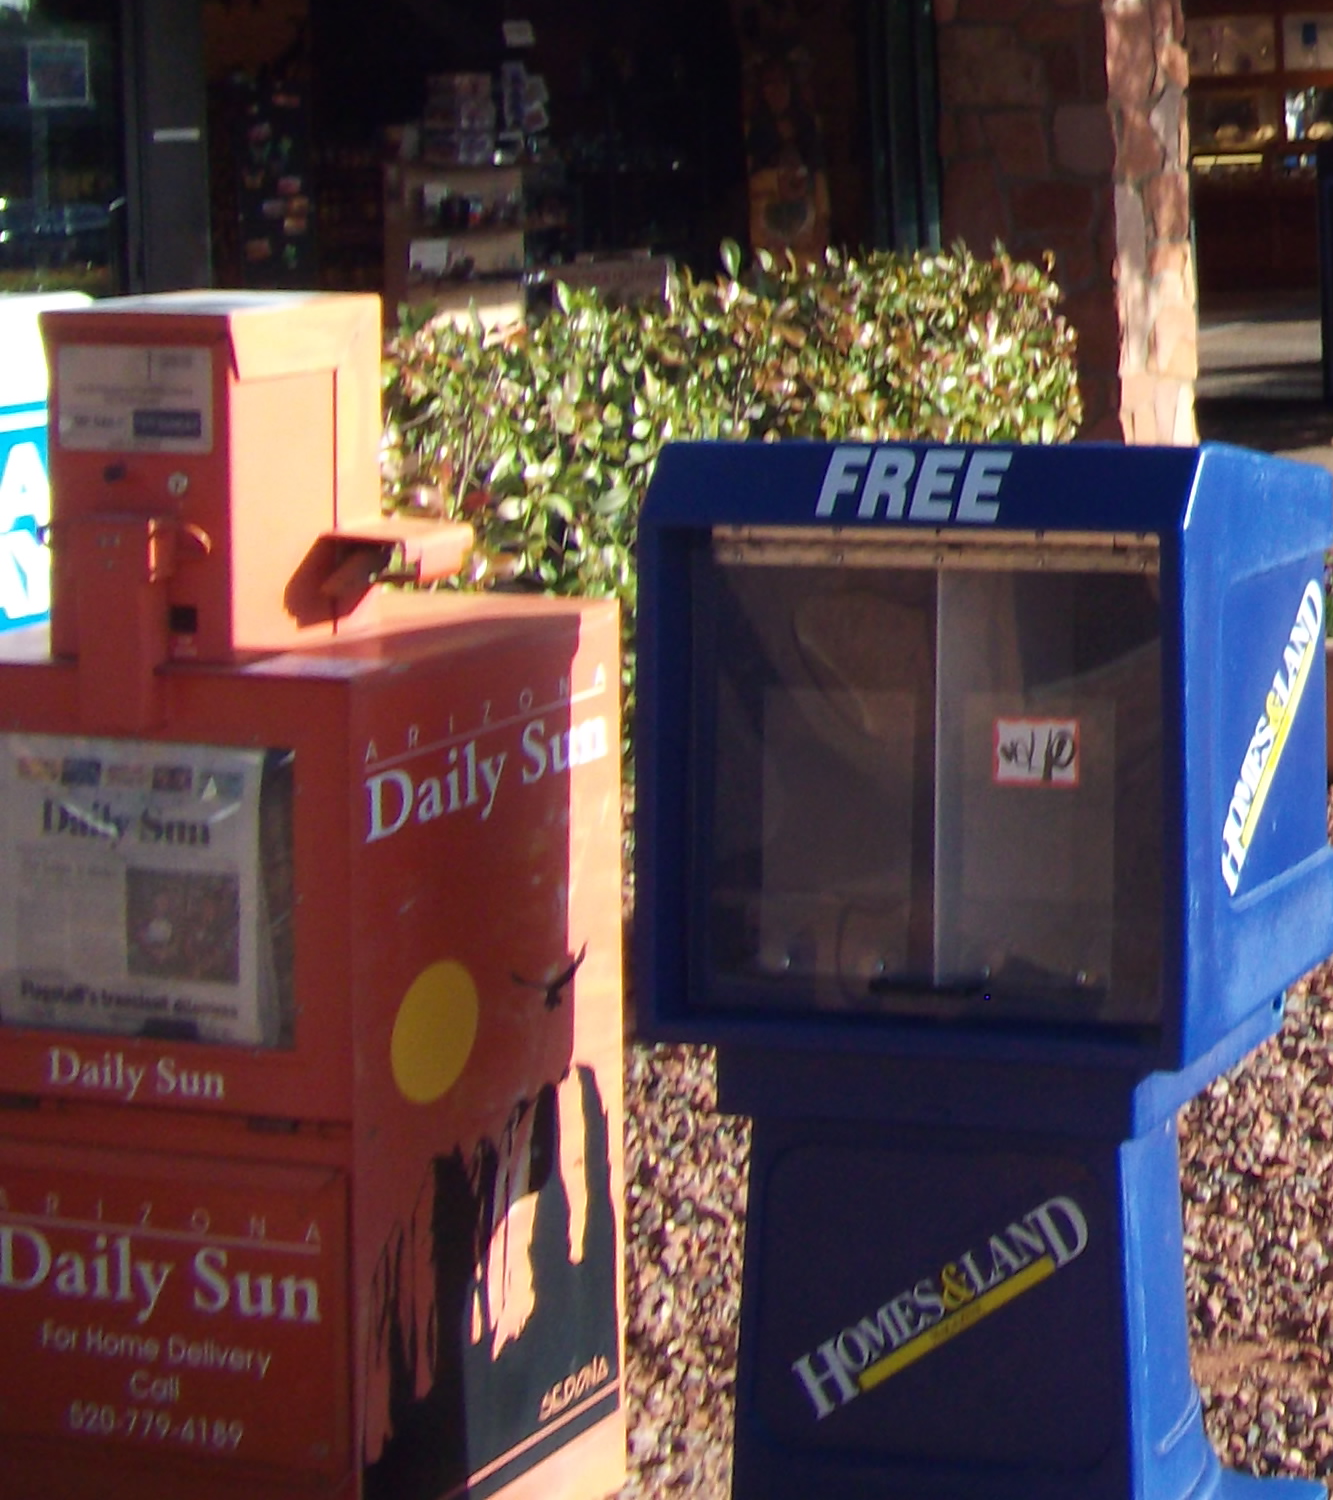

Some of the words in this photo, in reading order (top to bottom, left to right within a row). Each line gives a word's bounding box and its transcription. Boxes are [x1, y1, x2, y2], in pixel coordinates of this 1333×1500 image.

[815, 447, 1013, 522] FREE
[365, 662, 606, 764] ARIZONA
[365, 739, 508, 844] Daily
[521, 715, 608, 786] Sun
[43, 798, 130, 849] Daily
[140, 807, 210, 843] Sun
[49, 1047, 145, 1102] Daily
[156, 1056, 225, 1098] Sun
[0, 1226, 175, 1325] Daily
[194, 1246, 321, 1324] Sun
[42, 1320, 77, 1351] For
[86, 1326, 159, 1362] Home
[168, 1334, 271, 1379] Delivery
[130, 1370, 180, 1401] Call
[538, 1354, 609, 1423] SEDONA
